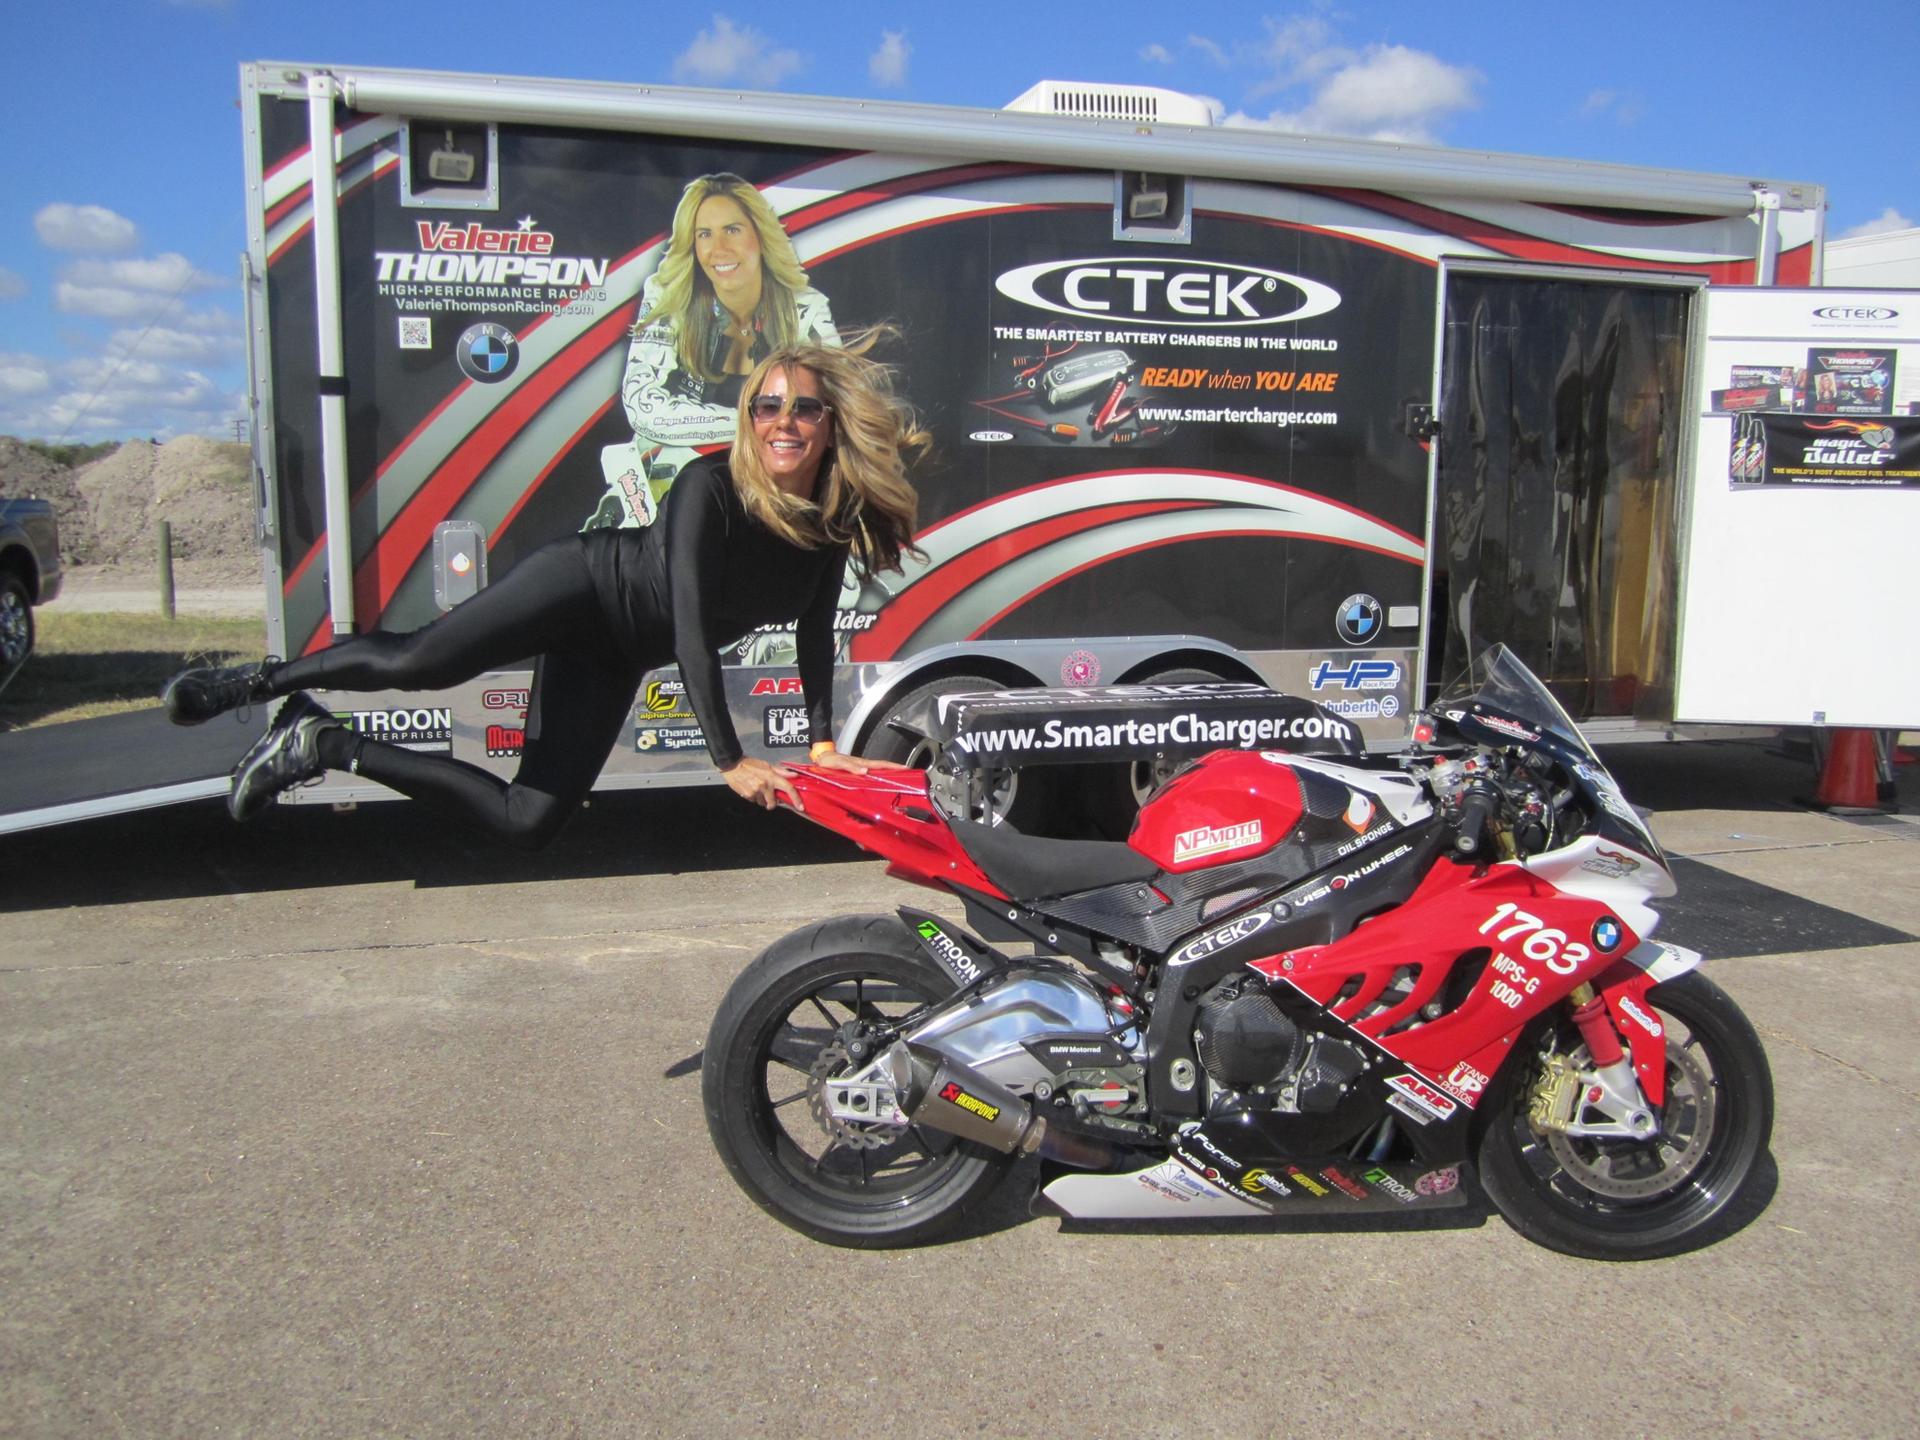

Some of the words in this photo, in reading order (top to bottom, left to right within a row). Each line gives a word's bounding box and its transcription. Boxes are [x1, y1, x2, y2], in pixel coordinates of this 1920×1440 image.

[416, 219, 554, 254] Valerie
[374, 252, 611, 286] THOMPSON
[379, 284, 542, 299] HIGH-PERFORMANCE
[548, 287, 606, 301] RACING
[395, 298, 594, 316] ValerieThompsonRacing.com
[994, 327, 1023, 340] THE
[1026, 328, 1102, 342] SMARTEST
[1105, 331, 1167, 345] BATTERY
[1169, 334, 1242, 348] CHARGERS
[1244, 336, 1259, 349] IN
[1261, 338, 1287, 350] THE
[1290, 339, 1338, 351] WORLD
[1140, 368, 1208, 389] READY
[1208, 369, 1251, 390] when
[1255, 371, 1296, 391] YOU
[1296, 373, 1339, 392] ARE
[1138, 407, 1338, 428] www.smartercharger.com
[1314, 661, 1396, 689] HP
[353, 709, 451, 732] TROON
[768, 718, 809, 736] UP
[956, 713, 1352, 754] www.SmarterCharger.com
[1295, 870, 1362, 906] VISION
[1361, 844, 1413, 875] WHEEL
[1478, 902, 1590, 975] 1763
[927, 937, 970, 984] ENTERPRISES
[934, 931, 981, 980] TROON
[1491, 952, 1540, 994] MPS-G
[1489, 980, 1523, 1008] 1000
[1050, 1046, 1068, 1054] BMW
[1069, 1046, 1102, 1054] Motorrad
[1448, 1068, 1482, 1092] UP
[1457, 1061, 1490, 1085] STAND
[1394, 1076, 1454, 1111] ARP
[1440, 1080, 1473, 1104] PHOTOS
[1192, 1132, 1242, 1168] Forma
[1379, 1175, 1418, 1202] TROON
